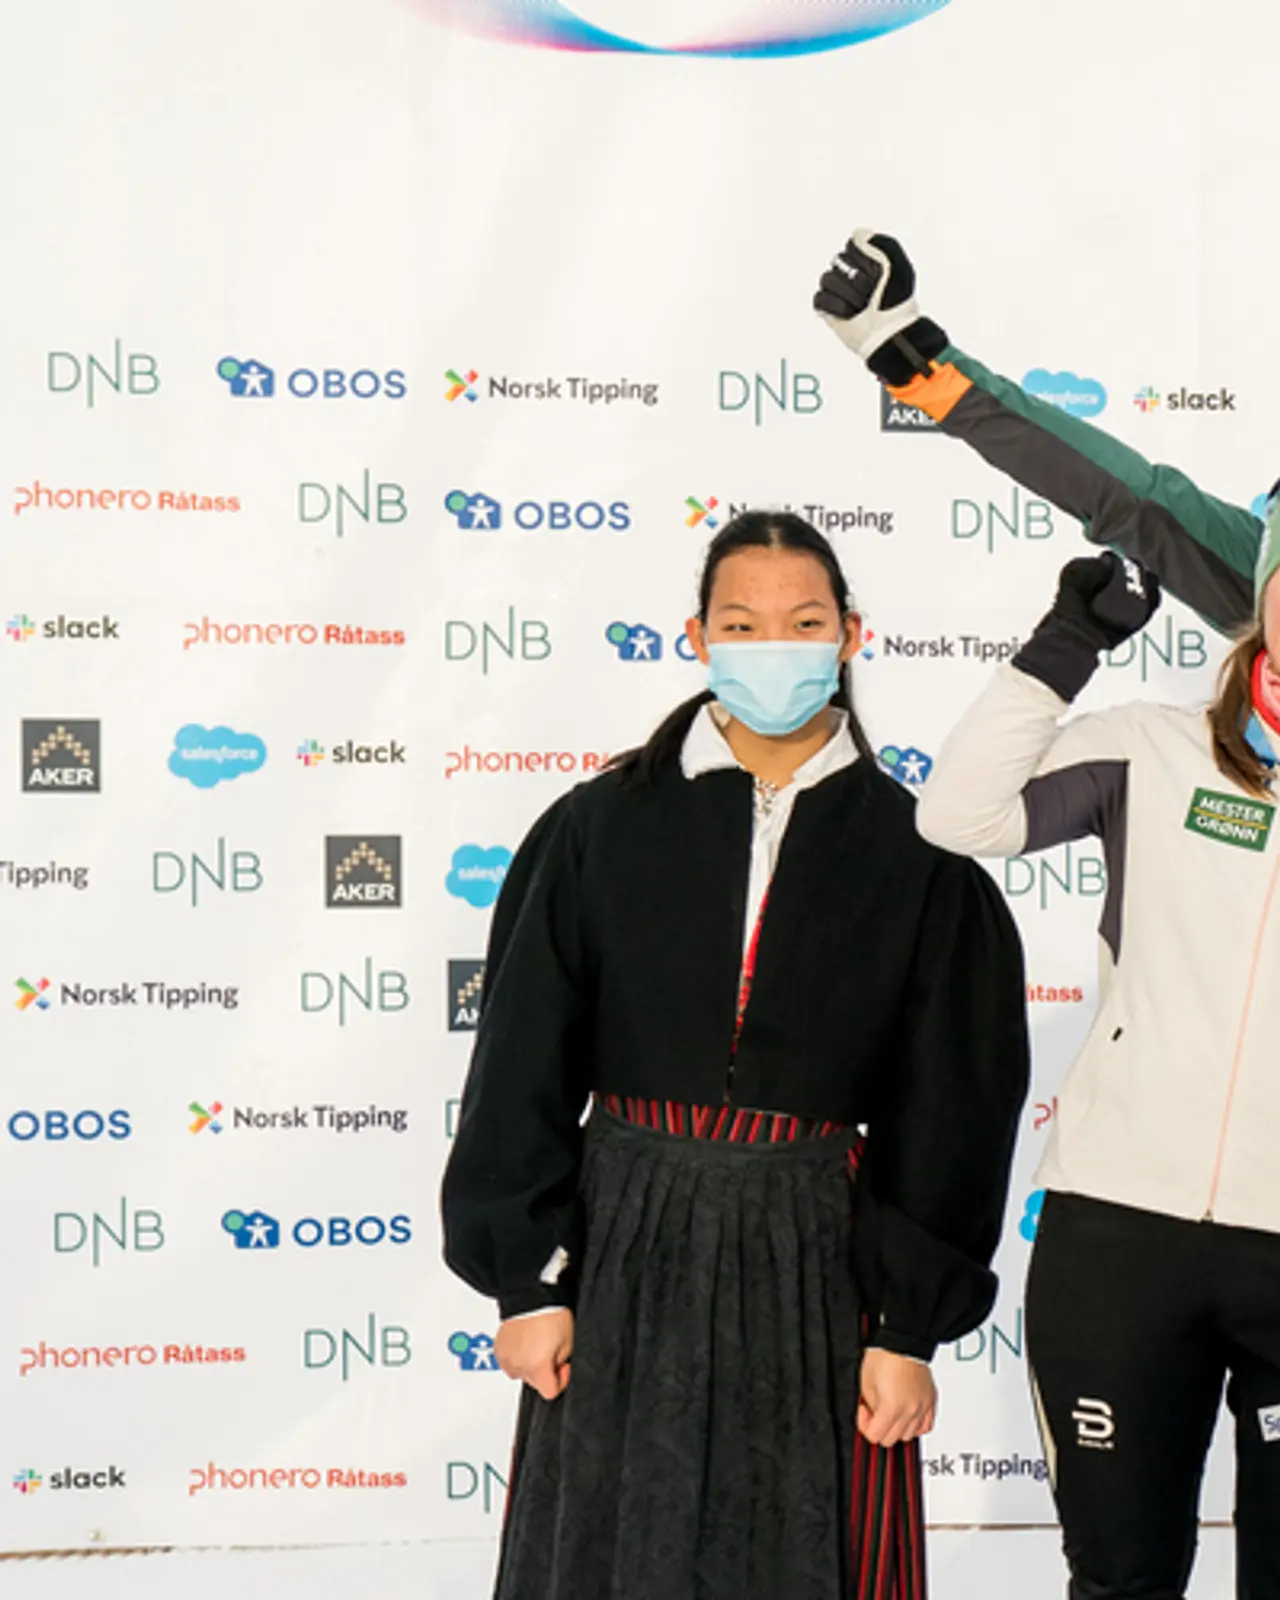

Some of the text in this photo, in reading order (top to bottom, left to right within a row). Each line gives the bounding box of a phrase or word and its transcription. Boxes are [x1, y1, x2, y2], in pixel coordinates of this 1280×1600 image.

[47, 338, 161, 408] DNB
[288, 368, 407, 400] OBOS
[487, 377, 659, 406] Norsk Tipping
[718, 358, 823, 426] DNB
[1166, 387, 1236, 410] slack
[14, 480, 242, 515] phonero Råtass
[297, 468, 408, 538] DNB
[513, 501, 631, 531] OBOS
[803, 505, 894, 535] Tipping
[951, 486, 1055, 554] DNB
[42, 615, 120, 640] slack
[183, 616, 406, 650] phonero Råtass
[445, 605, 552, 675] DNB
[883, 636, 954, 658] Norsk
[331, 741, 407, 765] slack
[445, 745, 576, 779] phonero
[28, 766, 95, 786] AKER
[1200, 796, 1266, 822] MESTER
[1195, 815, 1259, 844] GRØNN
[152, 837, 263, 907] DNB
[1004, 842, 1106, 911] DNB
[332, 883, 396, 901] AKER
[60, 982, 240, 1009] Norsk Tipping
[301, 956, 411, 1027] DNB
[8, 1109, 132, 1141] OBOS
[233, 1103, 409, 1134] Norsk Tipping
[53, 1196, 166, 1267] DNB
[292, 1215, 412, 1247] OBOS
[19, 1341, 247, 1377] phonero Råtass
[303, 1312, 412, 1381] DNB
[48, 1465, 126, 1490] slack
[188, 1461, 408, 1497] phonero Råtass
[959, 1452, 1049, 1482] Tipping
